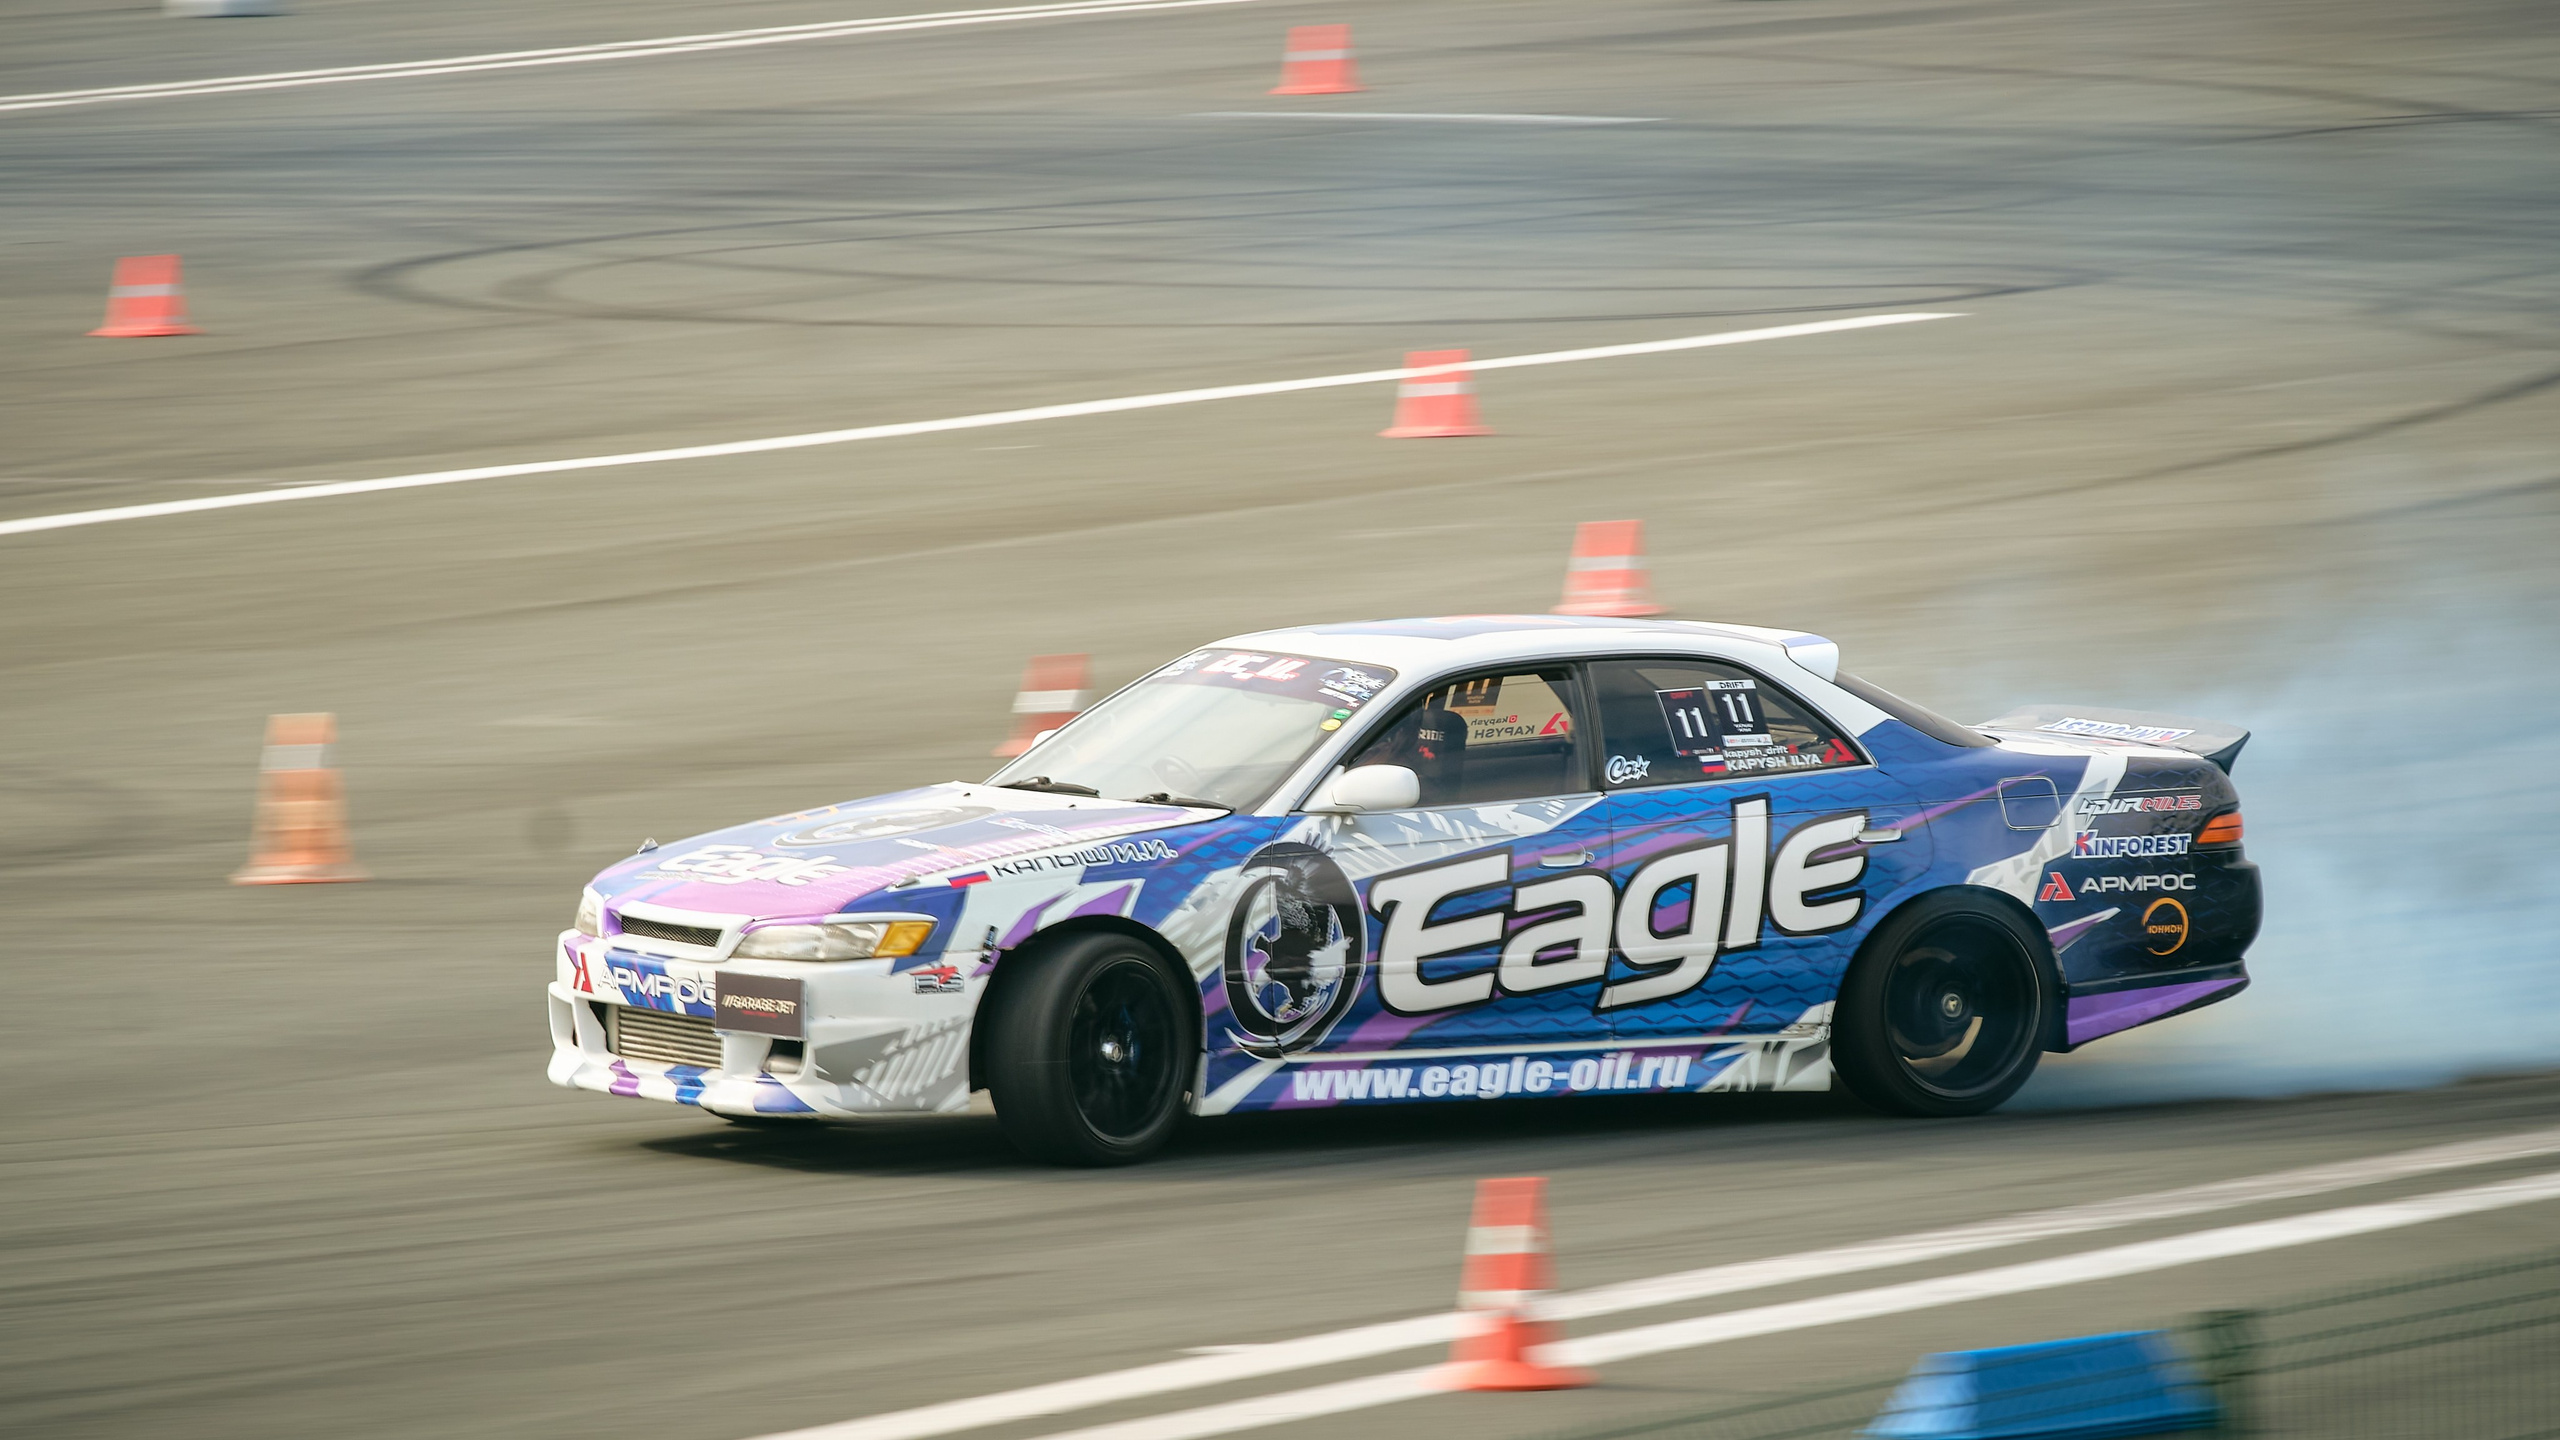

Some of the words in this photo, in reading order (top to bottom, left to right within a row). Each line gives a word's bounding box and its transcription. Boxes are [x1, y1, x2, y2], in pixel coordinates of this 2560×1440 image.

[1721, 693, 1754, 722] 11
[1675, 707, 1708, 738] 11
[1724, 745, 1789, 758] kapysh_drift
[1726, 756, 1787, 771] KAPYSH
[1790, 754, 1822, 766] ILYA
[2072, 829, 2192, 858] KINFOREST
[1370, 795, 1870, 1014] Eagle
[1293, 1052, 1692, 1100] www.eagle-oil.ru
